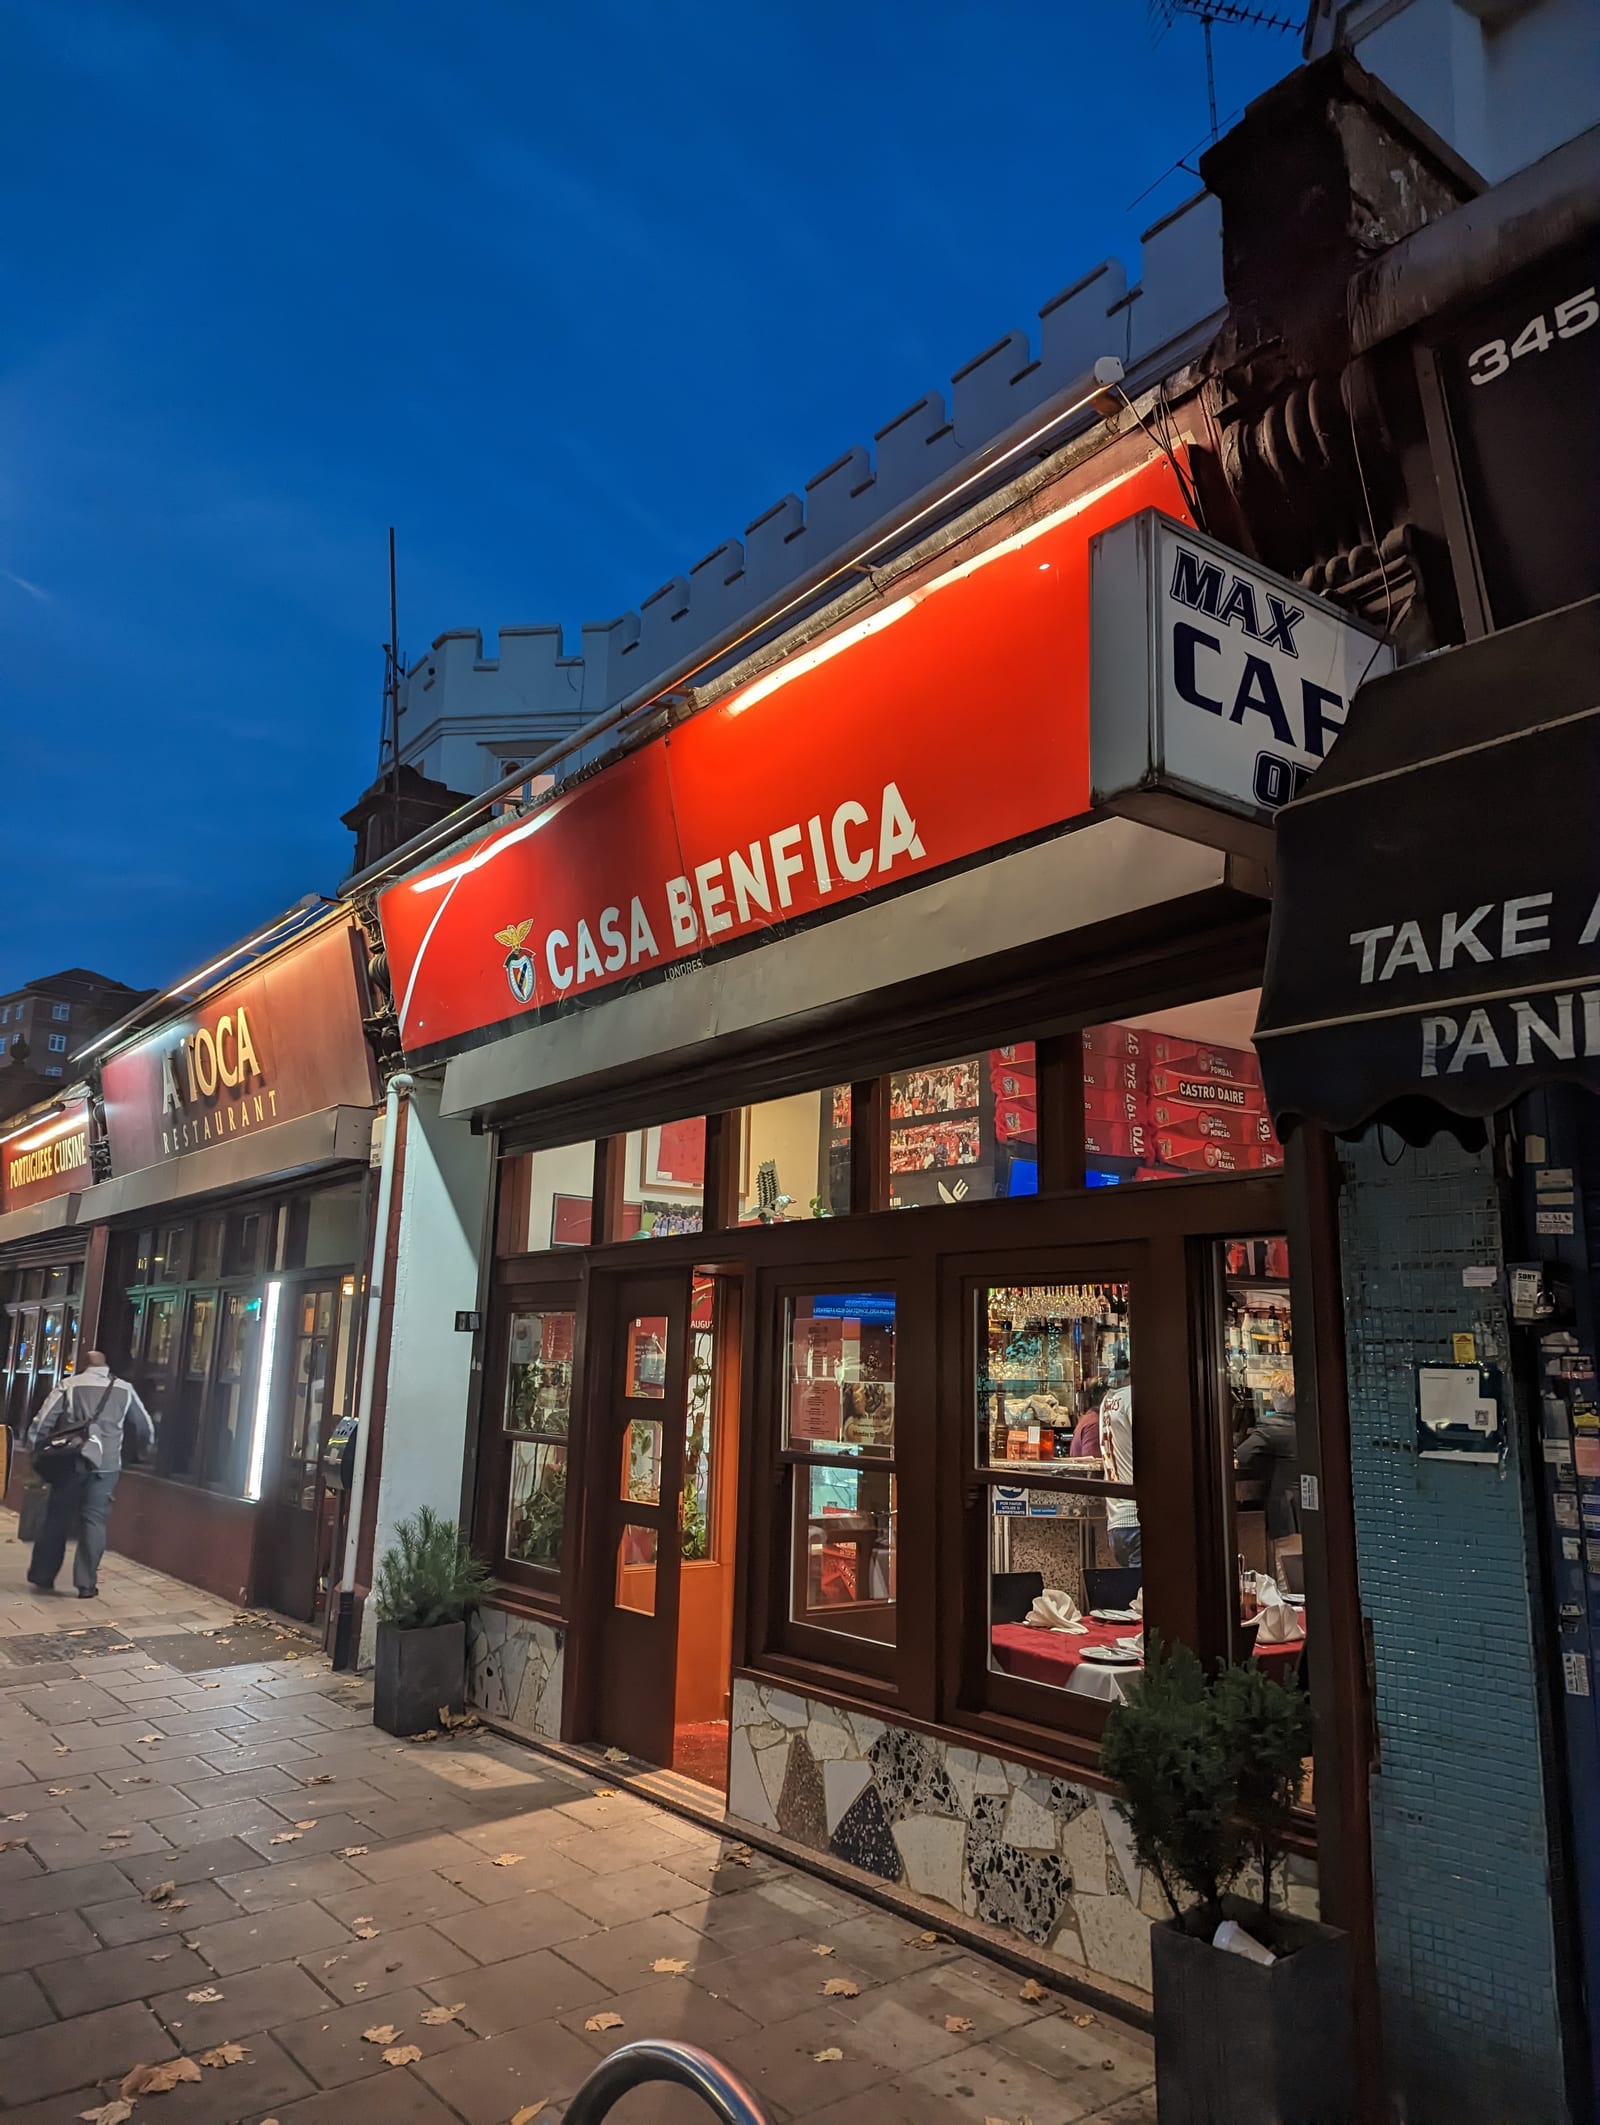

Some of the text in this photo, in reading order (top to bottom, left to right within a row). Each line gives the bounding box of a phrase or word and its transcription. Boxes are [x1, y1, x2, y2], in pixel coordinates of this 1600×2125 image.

[1468, 286, 1600, 386] 345
[1169, 544, 1305, 660] MAX
[544, 781, 928, 990] CASA BENFICA
[1349, 891, 1553, 985] TAKE
[663, 957, 703, 982] LONDRES
[162, 1006, 261, 1115] A TOCA
[1127, 1032, 1140, 1055] 37
[162, 1089, 277, 1154] RESTAURANT
[1126, 1092, 1137, 1121] 197
[1179, 1082, 1245, 1104] CASTRO DAIRE
[1132, 1126, 1145, 1156] 170
[1259, 1117, 1272, 1142] 161
[10, 1132, 87, 1189] PORTUGUESE CUISINE
